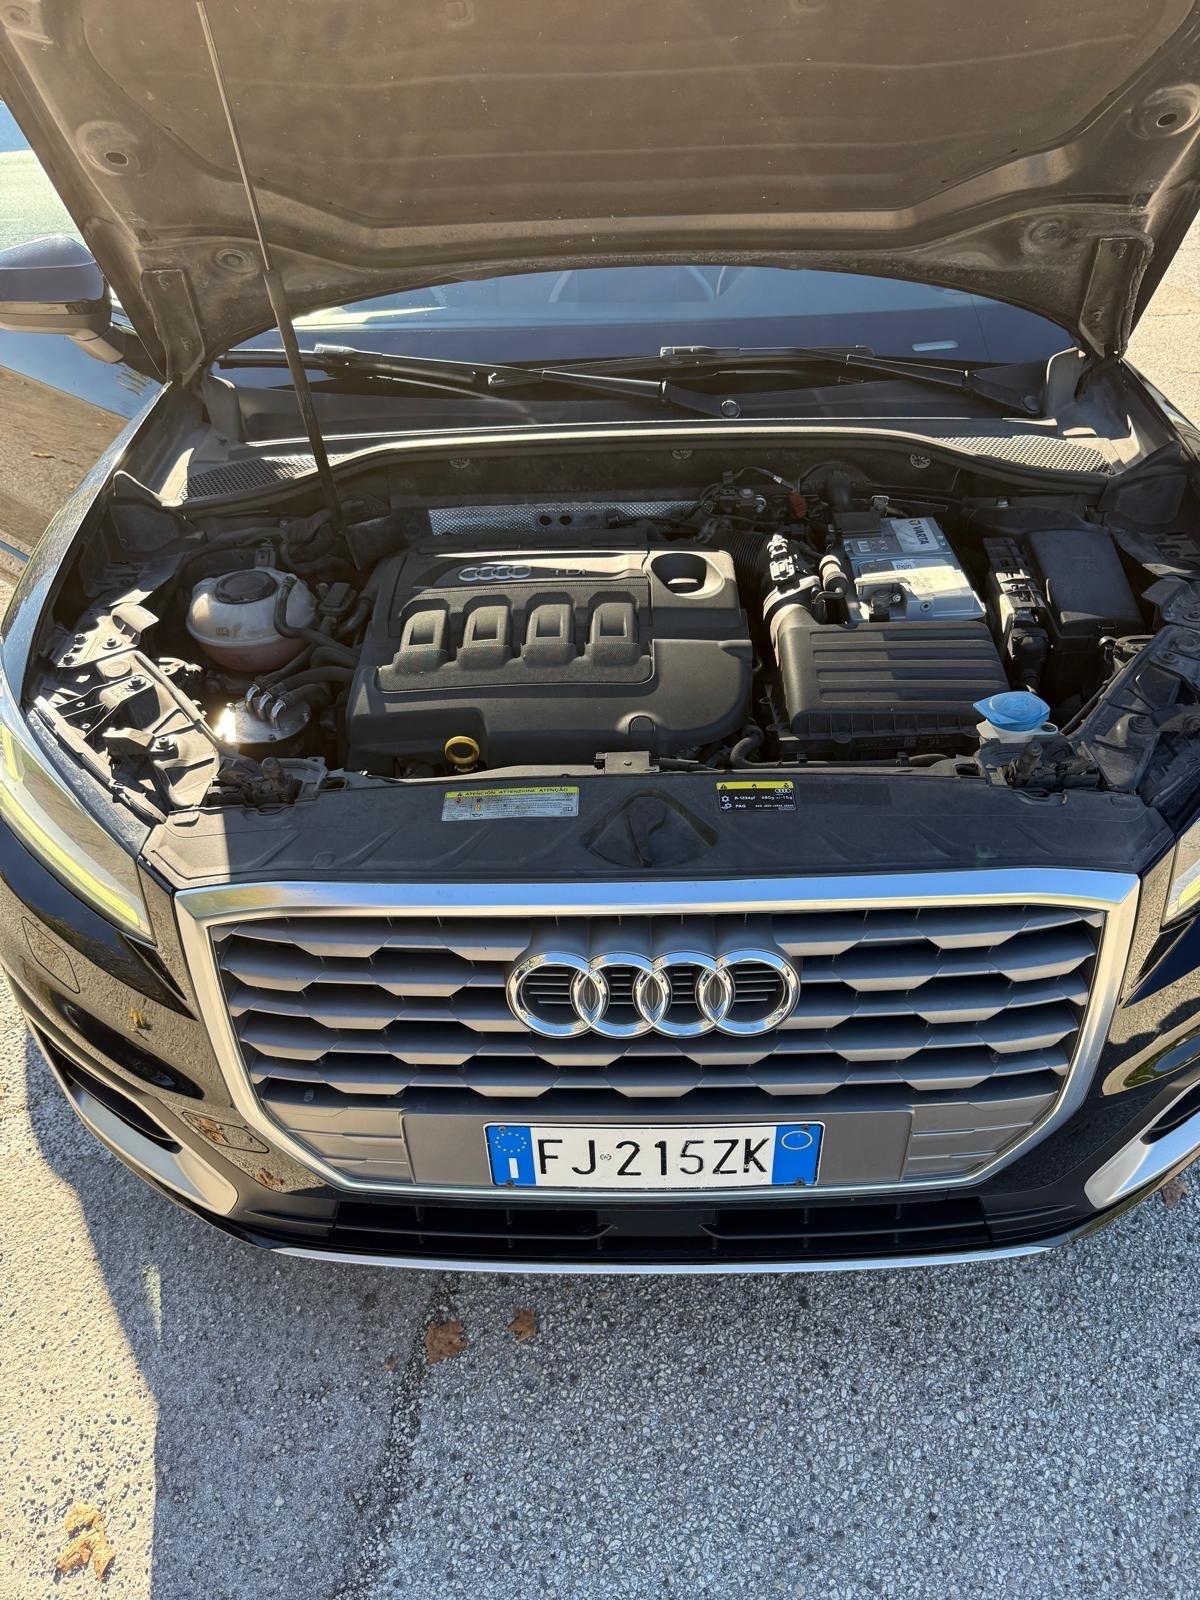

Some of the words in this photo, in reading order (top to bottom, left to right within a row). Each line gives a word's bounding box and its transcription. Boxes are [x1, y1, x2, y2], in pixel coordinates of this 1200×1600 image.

[912, 525, 930, 545] VARTA
[537, 1138, 596, 1175] FJ
[615, 1137, 771, 1176] 215ZK
